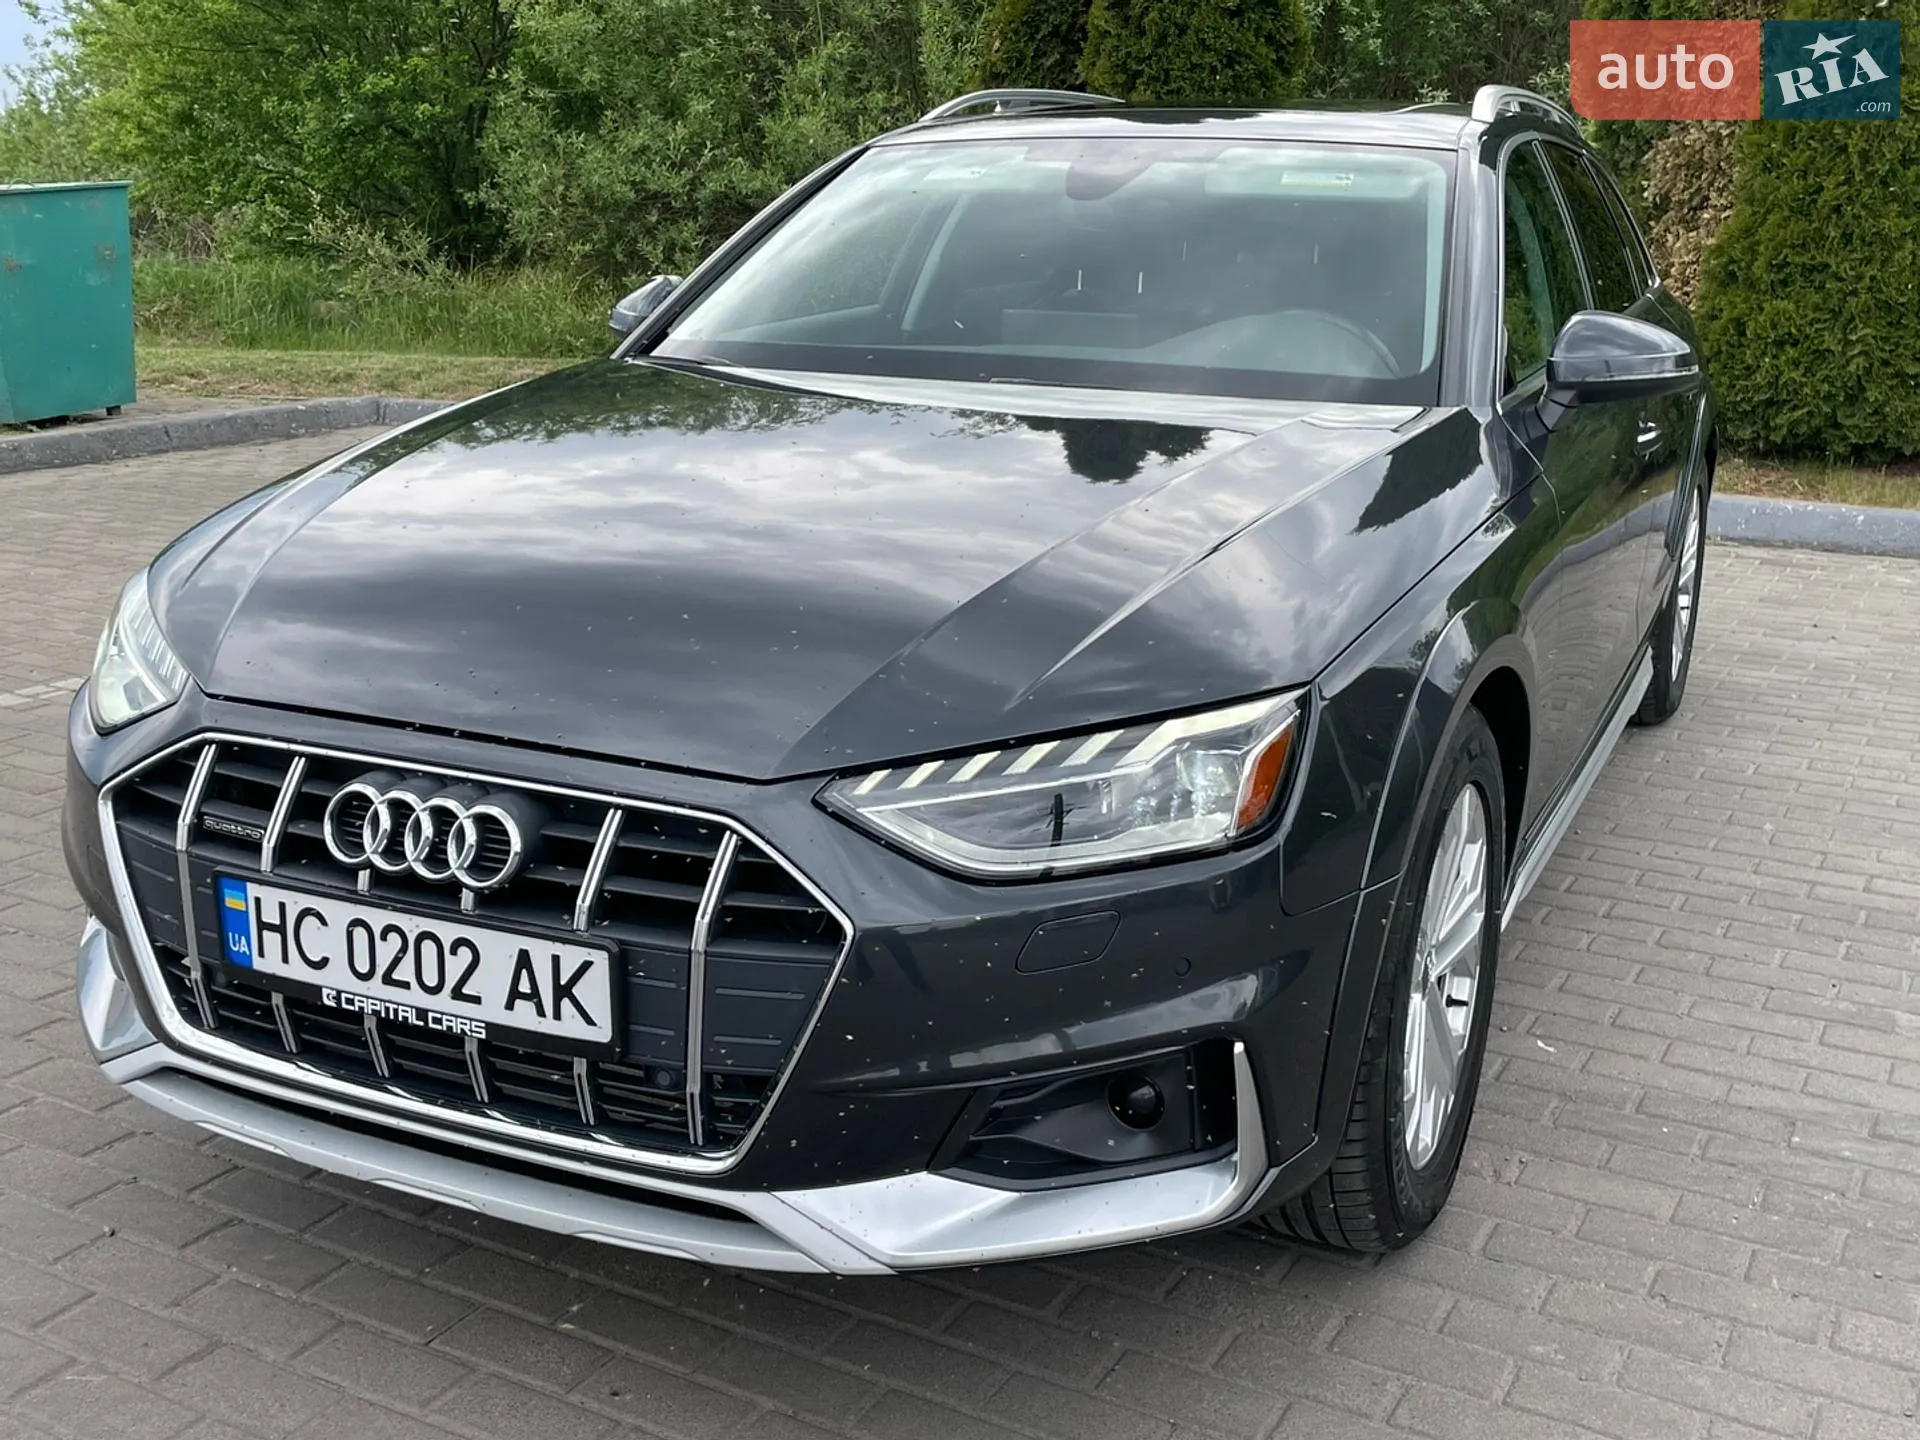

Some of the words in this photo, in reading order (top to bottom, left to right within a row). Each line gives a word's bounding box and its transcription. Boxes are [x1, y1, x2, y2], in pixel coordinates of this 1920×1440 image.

[205, 820, 261, 839] quattro
[228, 932, 250, 956] UA
[254, 896, 330, 970] HC
[346, 917, 482, 1005] 0202
[504, 948, 598, 1027] AK
[341, 992, 424, 1026] CAPITAL
[428, 1011, 487, 1040] CARS
